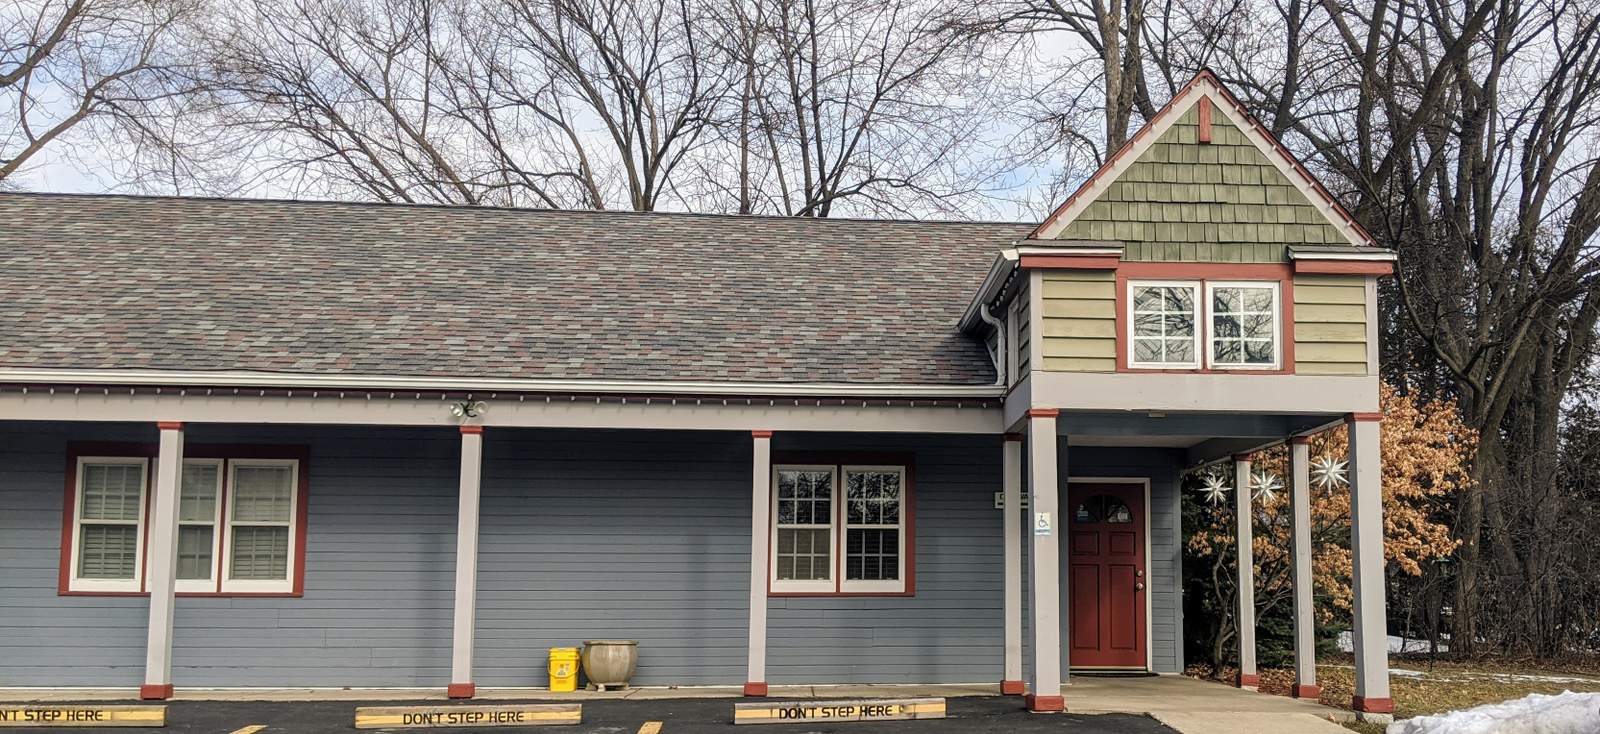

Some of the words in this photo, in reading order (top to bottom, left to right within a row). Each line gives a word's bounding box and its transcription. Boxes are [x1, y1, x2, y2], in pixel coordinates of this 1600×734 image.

[0, 710, 19, 721] N'T
[25, 710, 61, 721] STEP
[66, 710, 103, 721] HERE
[403, 713, 443, 725] DON'T
[448, 712, 484, 724] STEP
[489, 711, 524, 723] HERE
[779, 708, 817, 719] DON'T
[821, 707, 854, 718] STEP
[860, 705, 892, 717] HERE
